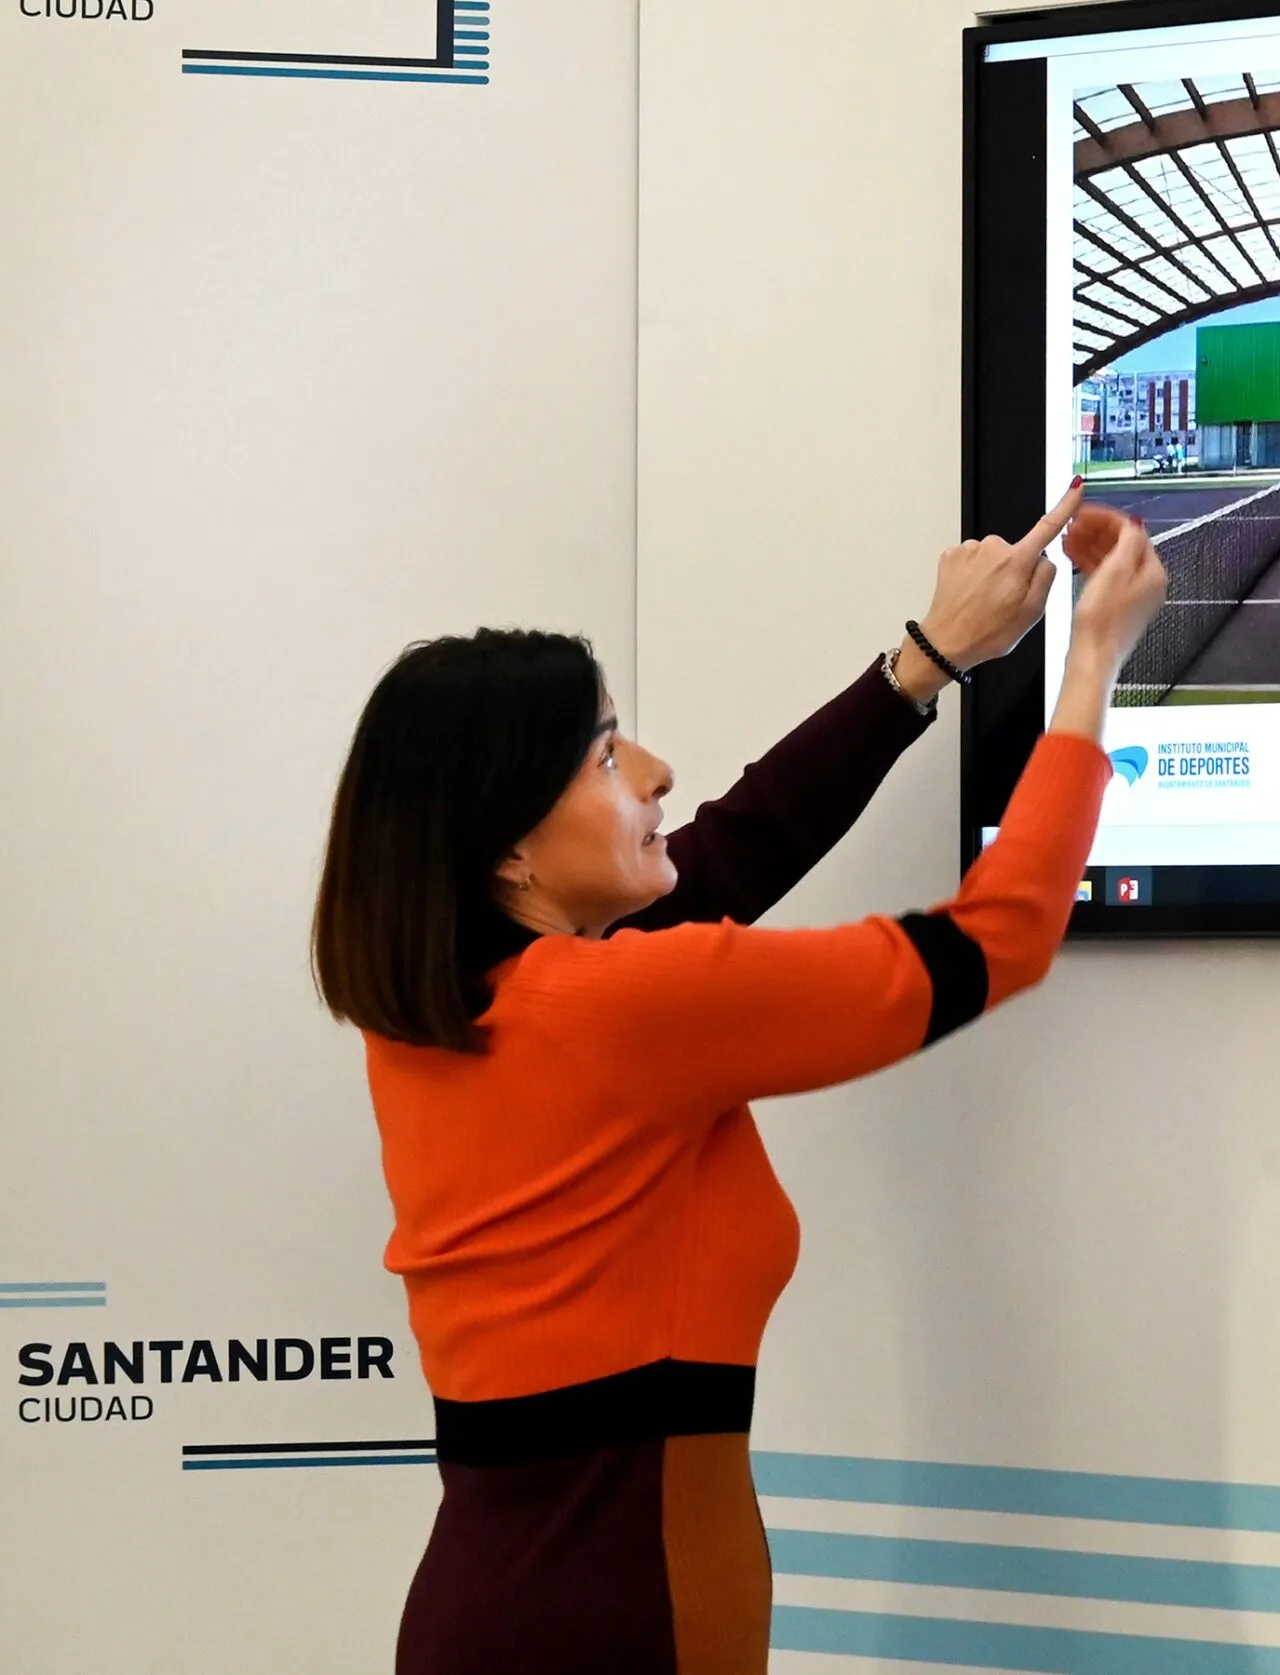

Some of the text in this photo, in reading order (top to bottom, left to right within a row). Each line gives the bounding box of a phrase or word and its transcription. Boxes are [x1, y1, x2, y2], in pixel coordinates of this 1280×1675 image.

[20, 0, 154, 21] CIUDAD
[1158, 742, 1250, 754] INSTITUTO MUNICIPAL
[1158, 757, 1250, 776] DE DEPORTES
[18, 1336, 395, 1387] SANTANDER
[18, 1395, 154, 1422] CIUDAD
